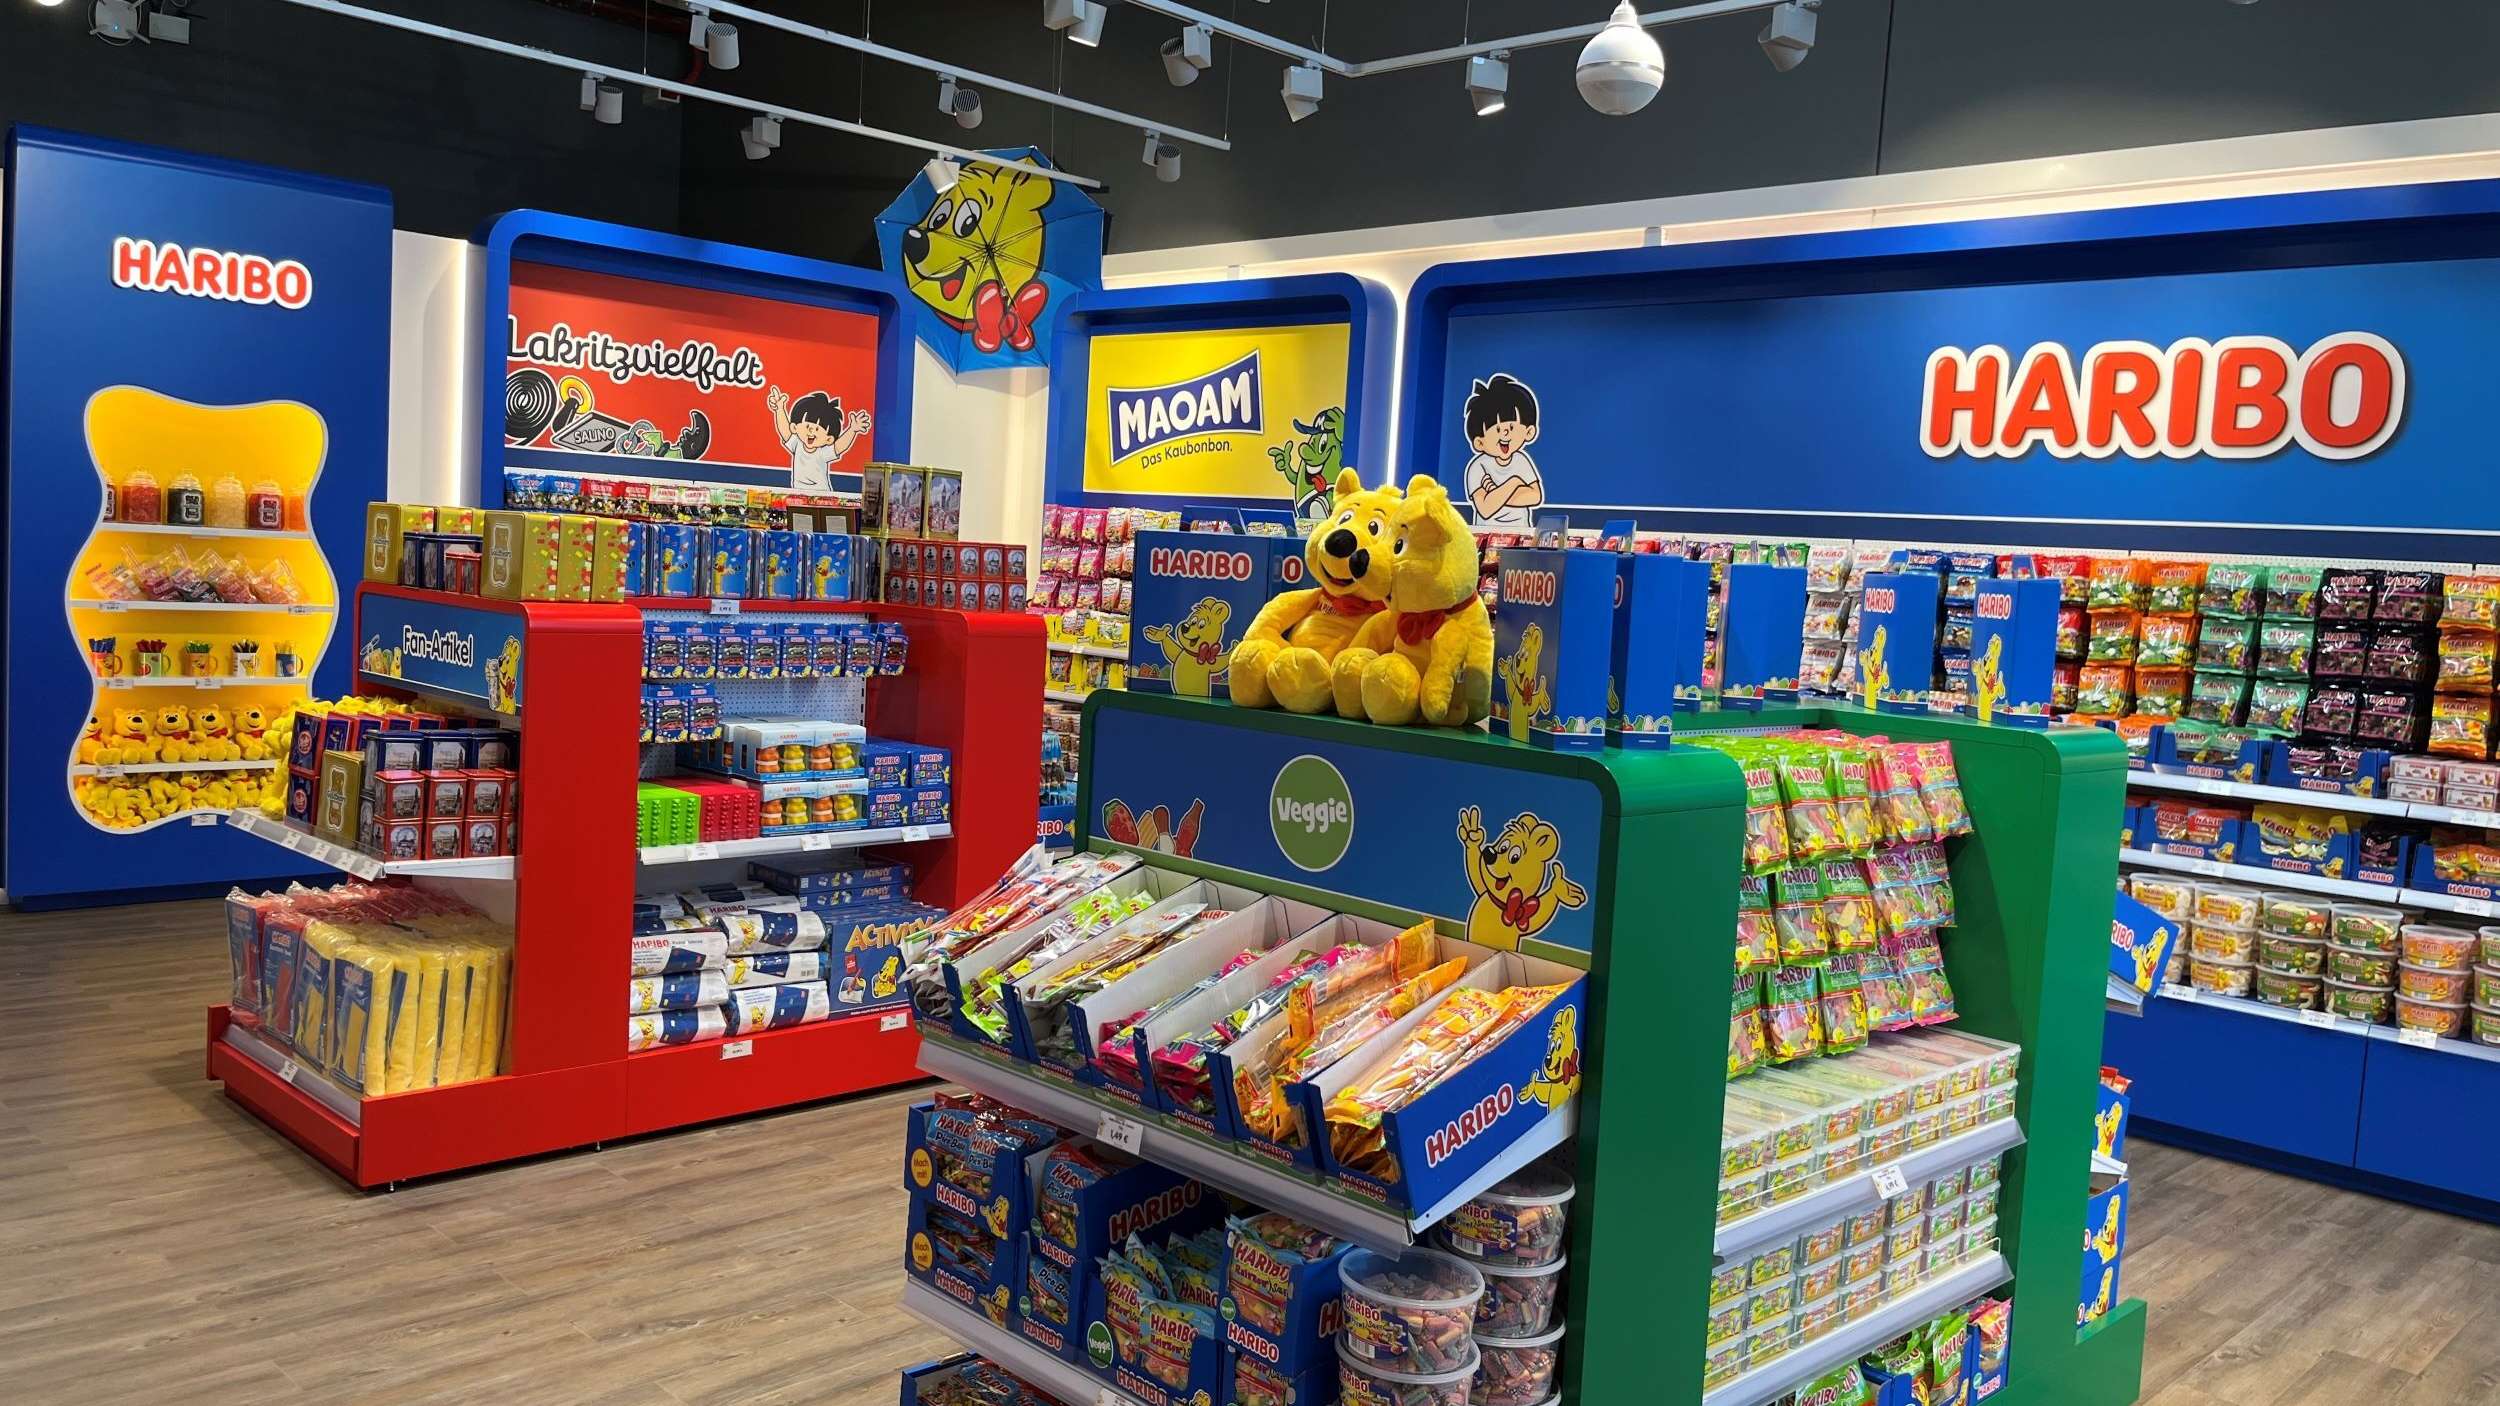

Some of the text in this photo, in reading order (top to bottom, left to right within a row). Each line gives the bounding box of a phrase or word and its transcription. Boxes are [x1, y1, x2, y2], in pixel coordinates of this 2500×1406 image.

[115, 238, 311, 308] HARIBO
[507, 316, 763, 392] Lakritzvielfalt
[1925, 337, 2398, 453] HARIBO
[1118, 370, 1251, 451] MAOAM
[1141, 439, 1233, 469] Das Kaubonbon.
[1151, 548, 1252, 581] HARIBO
[1504, 569, 1556, 607] HARIBO
[1865, 588, 1895, 614] HARIBO
[1977, 593, 2011, 619] HARIBO
[403, 624, 474, 668] Fan-Artikel
[875, 756, 900, 765] HARIBO
[920, 754, 943, 762] HARIBO
[2187, 765, 2223, 778] HARIBO
[876, 794, 901, 803] HARIBO
[918, 791, 942, 801] HARIBO
[2300, 778, 2341, 792] HARIBO
[1037, 820, 1063, 835] RIBO
[1276, 797, 1348, 833] Veggie
[2261, 818, 2296, 837] HARIB
[2167, 843, 2204, 857] HARIBO
[2272, 858, 2311, 871] HARIBO
[2359, 870, 2394, 882] HARIBO
[2448, 883, 2491, 898] HARIBO
[710, 905, 746, 914] HARIBO
[633, 939, 669, 949] HARIBO
[2112, 919, 2134, 951] RIBO
[936, 1115, 971, 1138] HARIB
[1425, 1084, 1514, 1168] HARIBO
[936, 1182, 977, 1217] HARIBO
[1110, 1180, 1201, 1244] HARIBO
[1458, 1204, 1490, 1219] RIBO
[1235, 1242, 1292, 1282] HARIBO
[935, 1268, 976, 1304] HARIBO
[1105, 1276, 1140, 1308] HARIB
[1023, 1318, 1063, 1351] HARIBO
[1150, 1314, 1200, 1343] HARIBO
[1227, 1321, 1280, 1363] HARIBO
[1117, 1365, 1168, 1406] HARIBO
